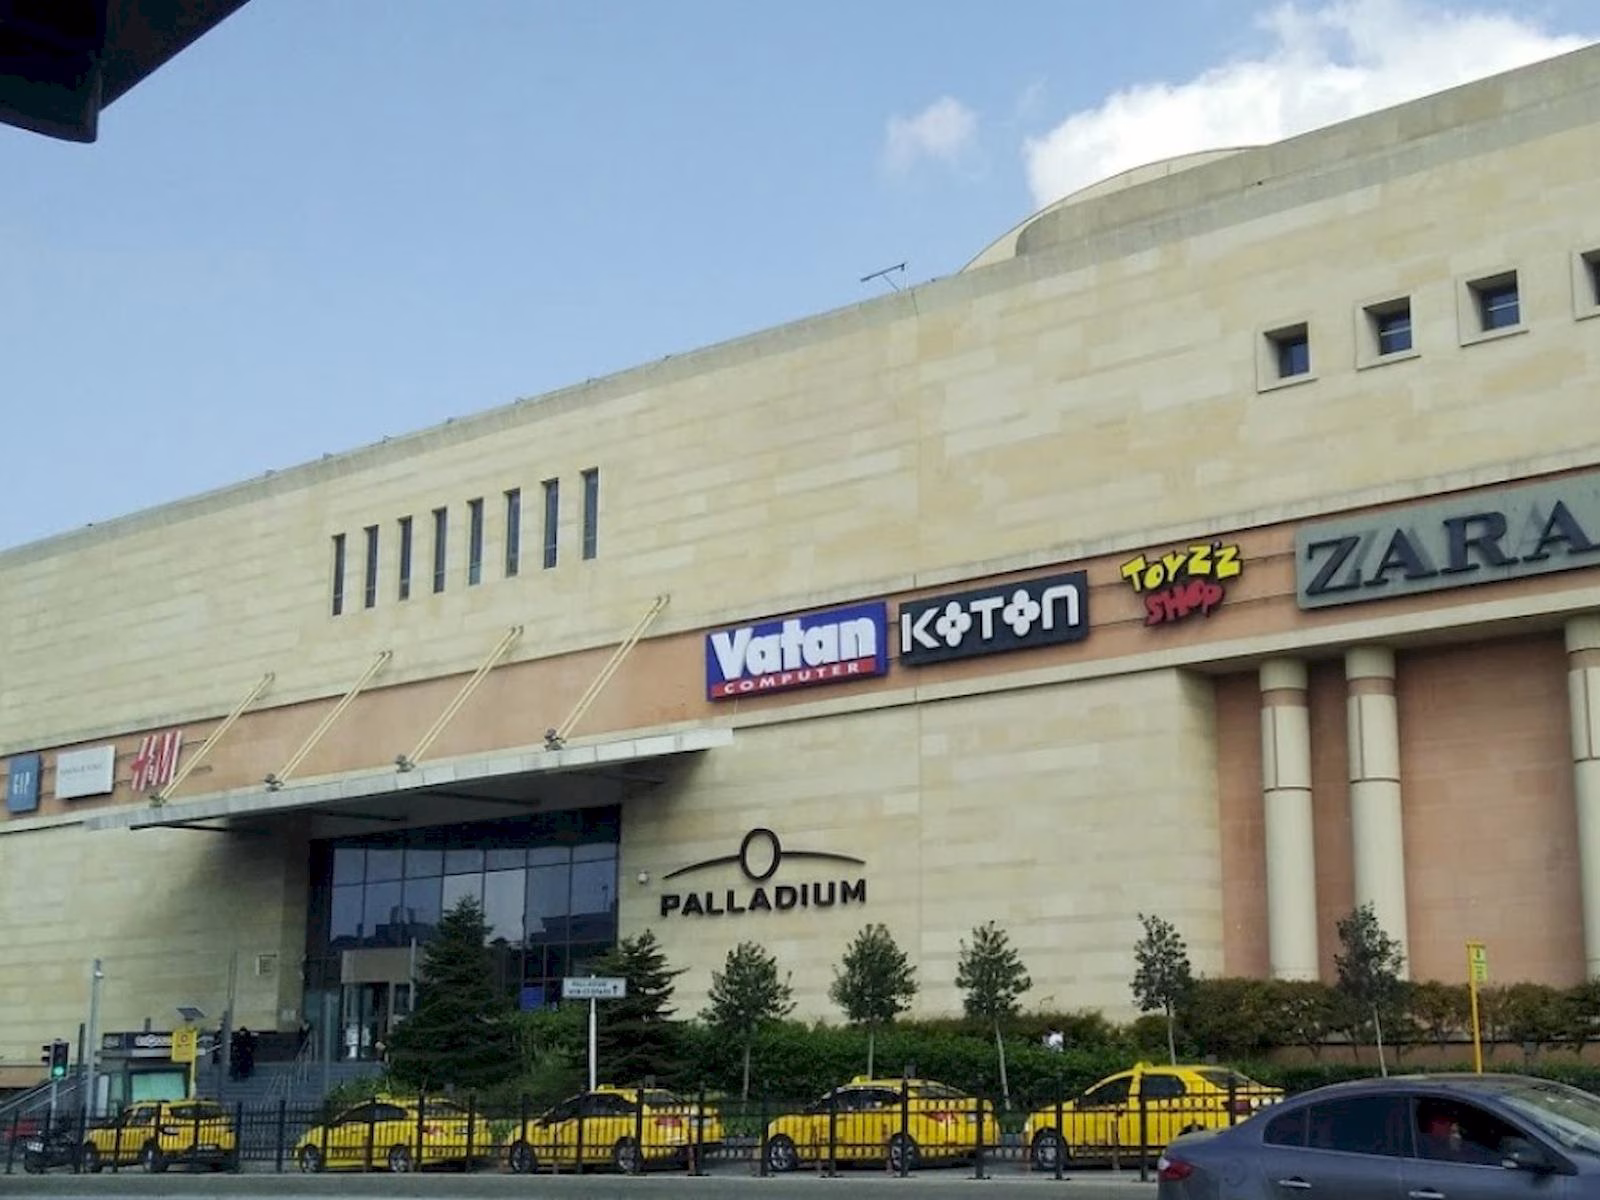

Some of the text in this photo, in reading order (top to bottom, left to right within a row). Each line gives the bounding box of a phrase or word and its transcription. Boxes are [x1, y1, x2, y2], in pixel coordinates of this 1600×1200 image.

[1305, 500, 1600, 596] ZARA
[711, 616, 877, 680] Vatan
[724, 662, 860, 695] COMPUTER
[660, 878, 867, 917] PALLADIUM
